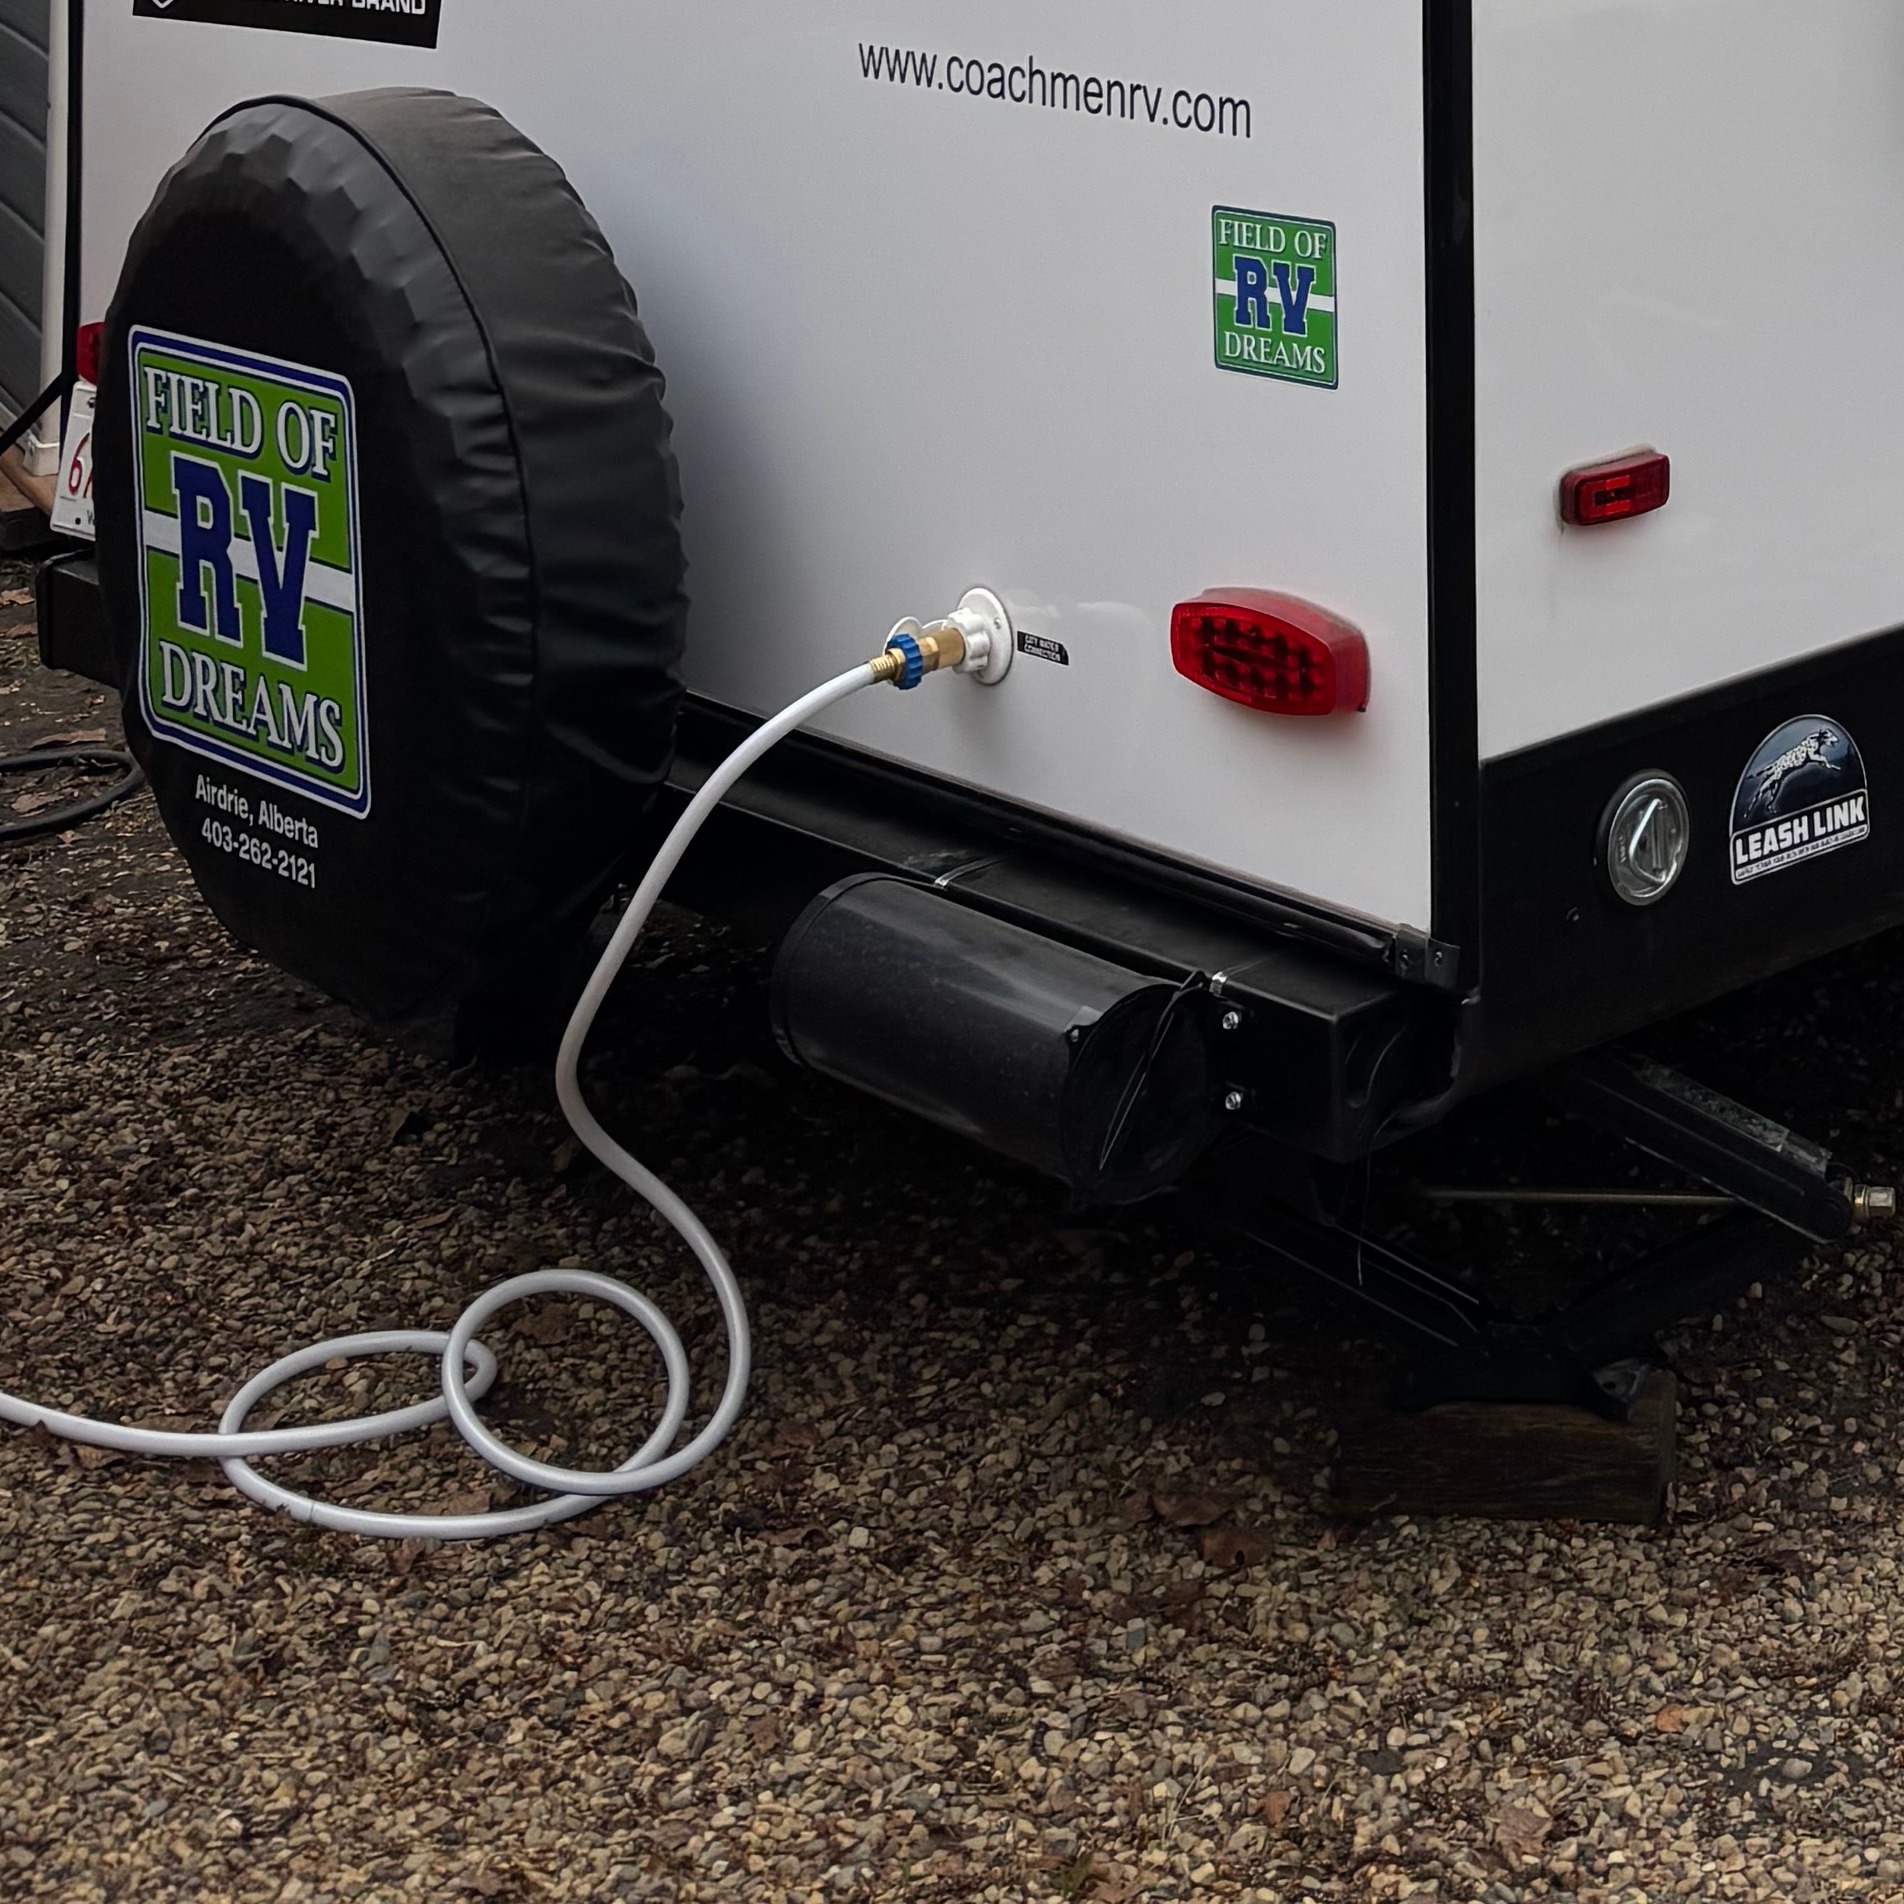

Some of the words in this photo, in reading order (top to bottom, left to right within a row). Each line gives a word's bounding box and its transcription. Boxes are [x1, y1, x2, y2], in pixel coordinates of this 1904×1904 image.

[857, 42, 1252, 139] www.coachmenrv.com
[1218, 218, 1286, 253] FIELD
[1294, 229, 1327, 260] OF
[1232, 252, 1317, 338] RV
[1223, 330, 1326, 374] DREAMS
[143, 365, 264, 457] FIELD
[276, 400, 337, 480] OF
[169, 449, 320, 673] RV
[158, 639, 345, 771] DREAMS
[194, 773, 254, 827] Airdrie,
[257, 799, 319, 849] Alberta
[1735, 814, 1809, 866] LEASH
[1813, 795, 1866, 837] LINK
[200, 817, 316, 889] 403-262-2121
